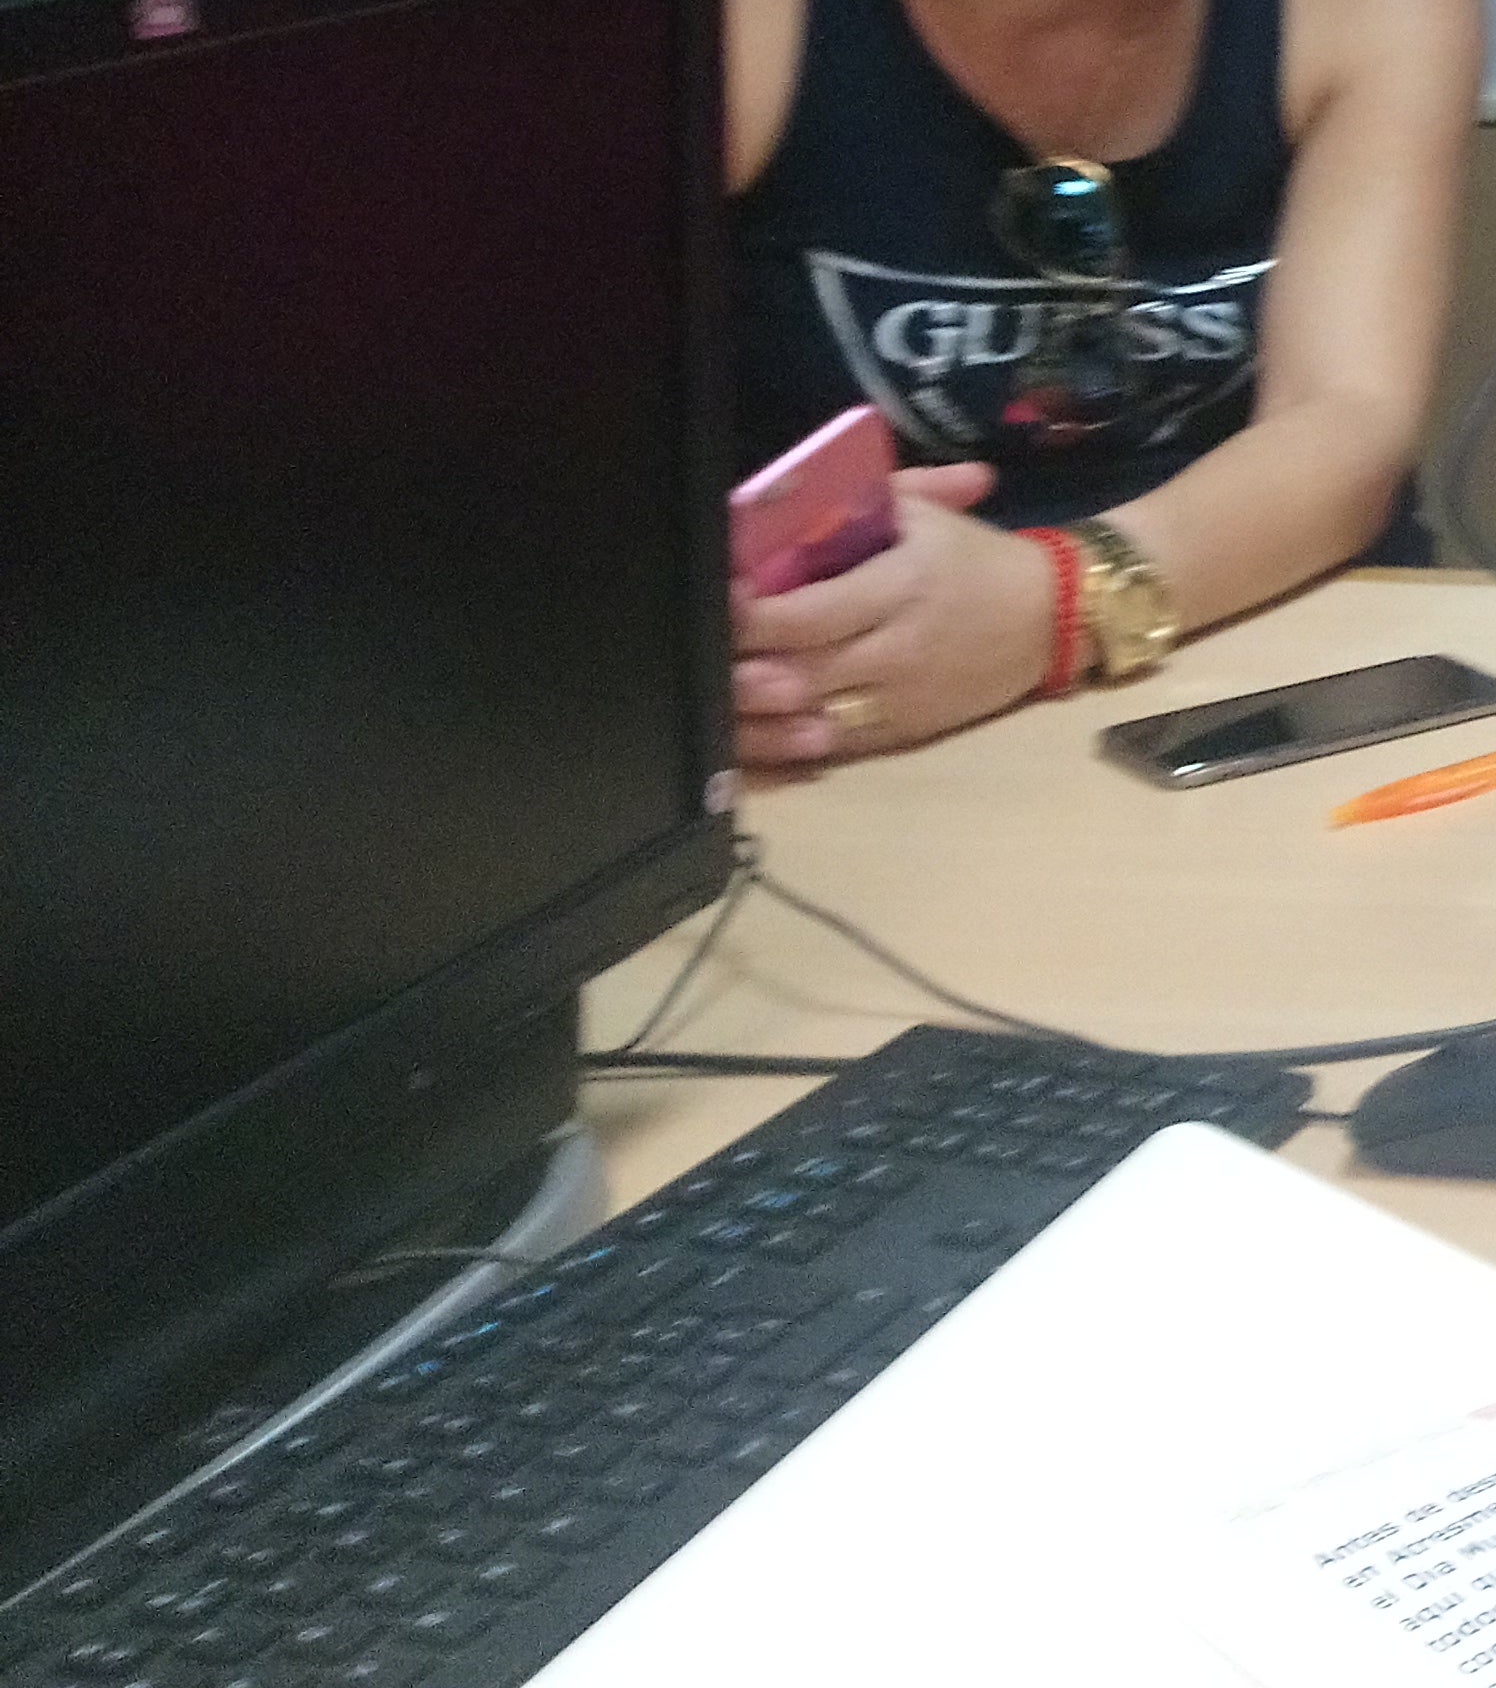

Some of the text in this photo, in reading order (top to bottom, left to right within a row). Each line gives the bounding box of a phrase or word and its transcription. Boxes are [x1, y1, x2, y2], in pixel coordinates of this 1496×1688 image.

[1313, 1521, 1401, 1568] Antes
[1404, 1502, 1445, 1523] de
[1342, 1564, 1380, 1589] en
[1371, 1590, 1401, 1611] el
